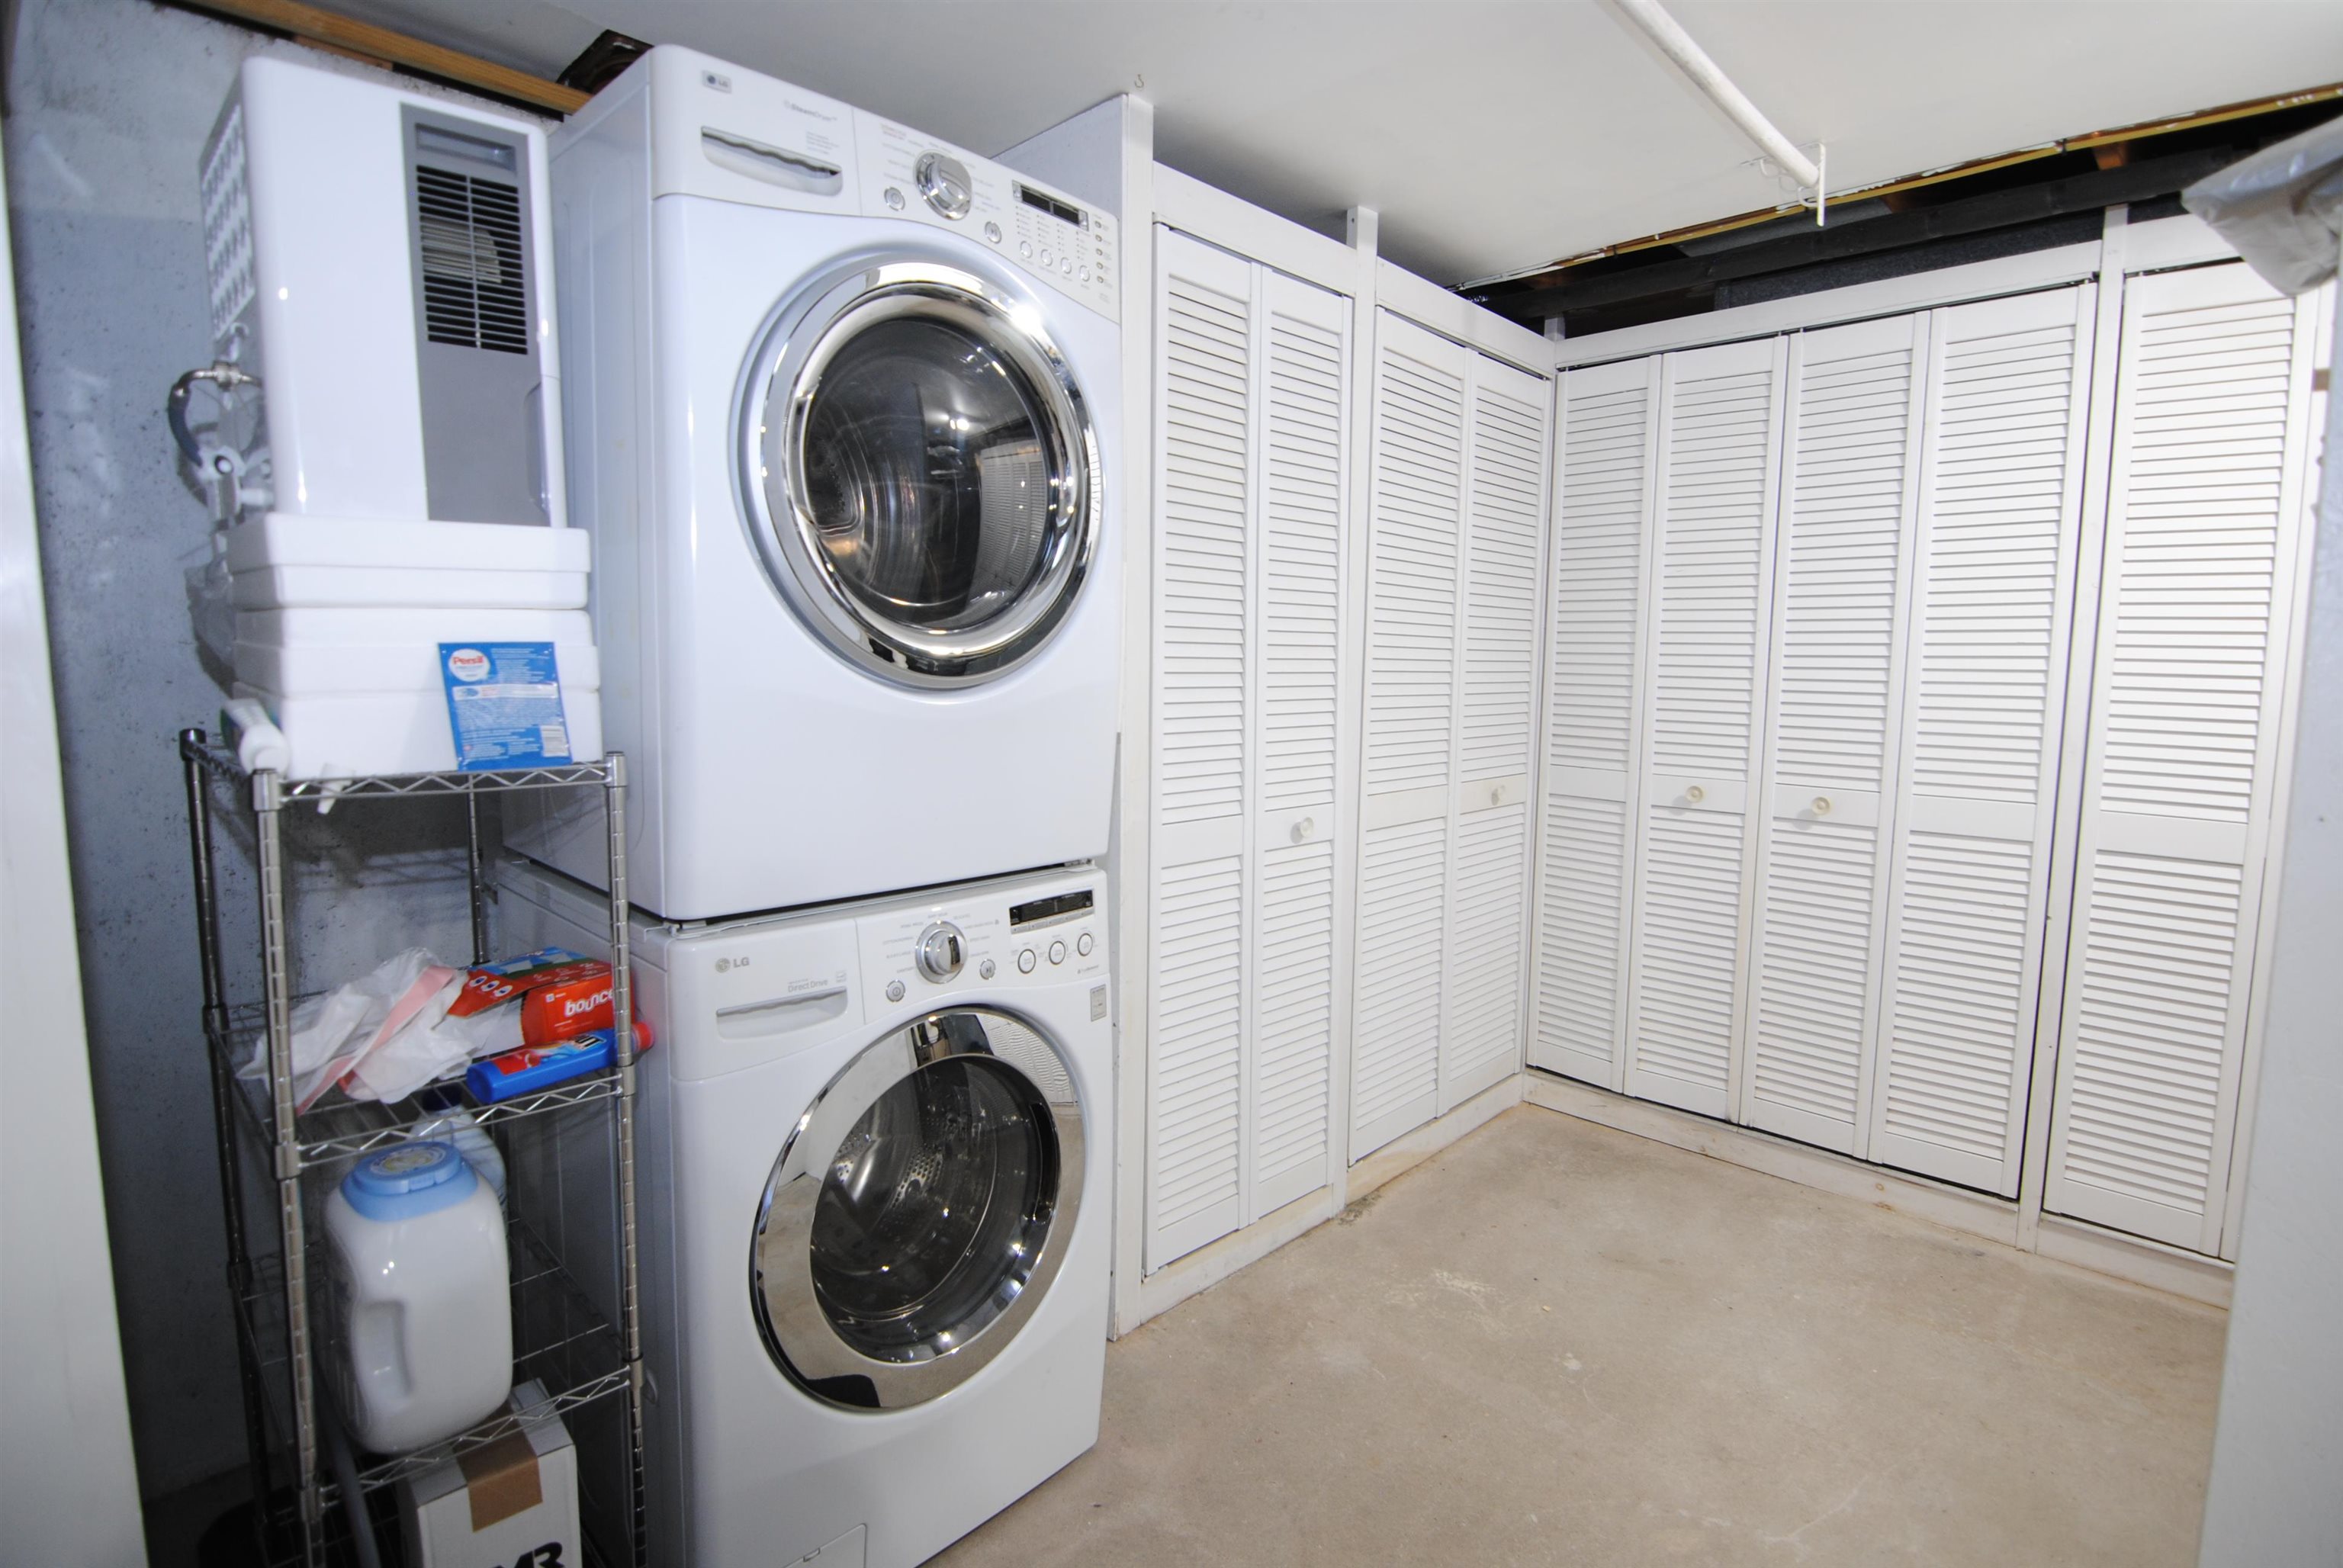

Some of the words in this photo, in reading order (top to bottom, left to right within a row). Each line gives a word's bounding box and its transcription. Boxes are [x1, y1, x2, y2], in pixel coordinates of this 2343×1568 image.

[452, 656, 484, 665] Persil
[733, 957, 750, 968] LG
[788, 982, 809, 993] Direct
[810, 978, 828, 989] Drive
